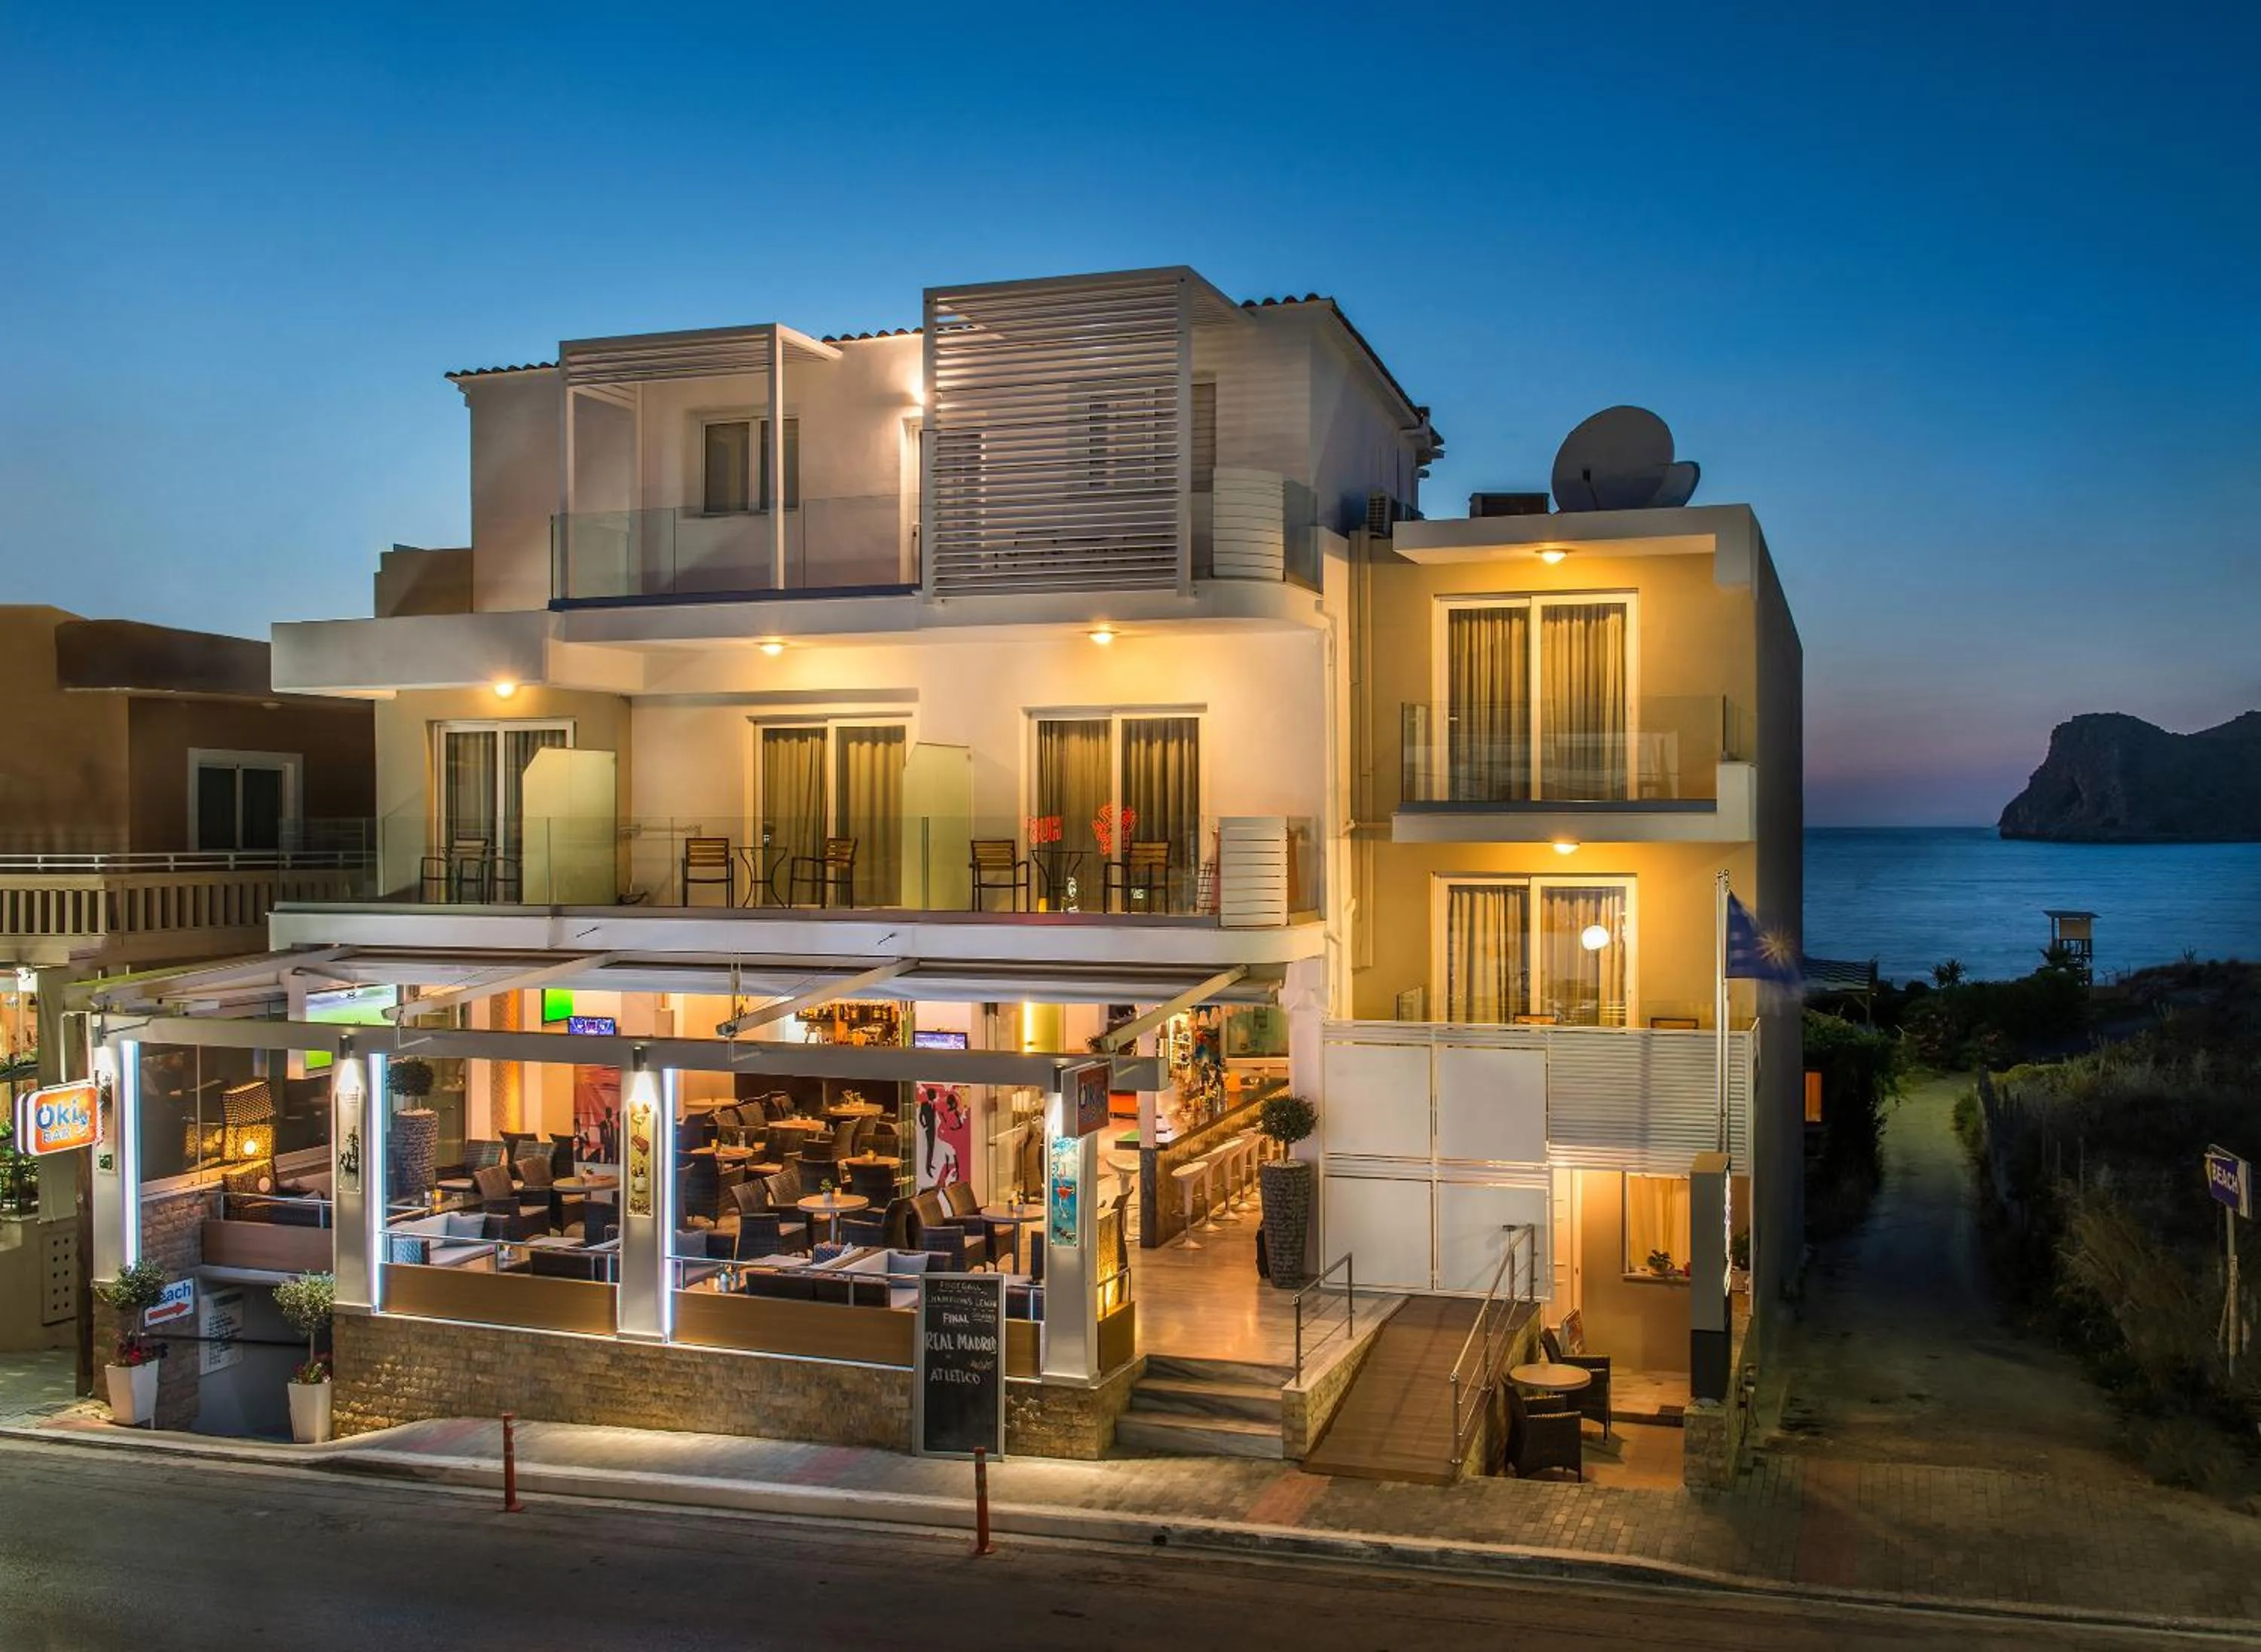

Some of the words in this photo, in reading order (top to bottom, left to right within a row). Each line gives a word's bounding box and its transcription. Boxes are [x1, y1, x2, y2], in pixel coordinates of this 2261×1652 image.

[43, 1127, 70, 1144] BAR
[2213, 1163, 2238, 1195] BEACH
[158, 1283, 191, 1304] each
[942, 1312, 971, 1324] FINAL
[926, 1331, 954, 1351] REAL
[956, 1333, 997, 1354] MADRID
[930, 1367, 981, 1384] ATLETICO
